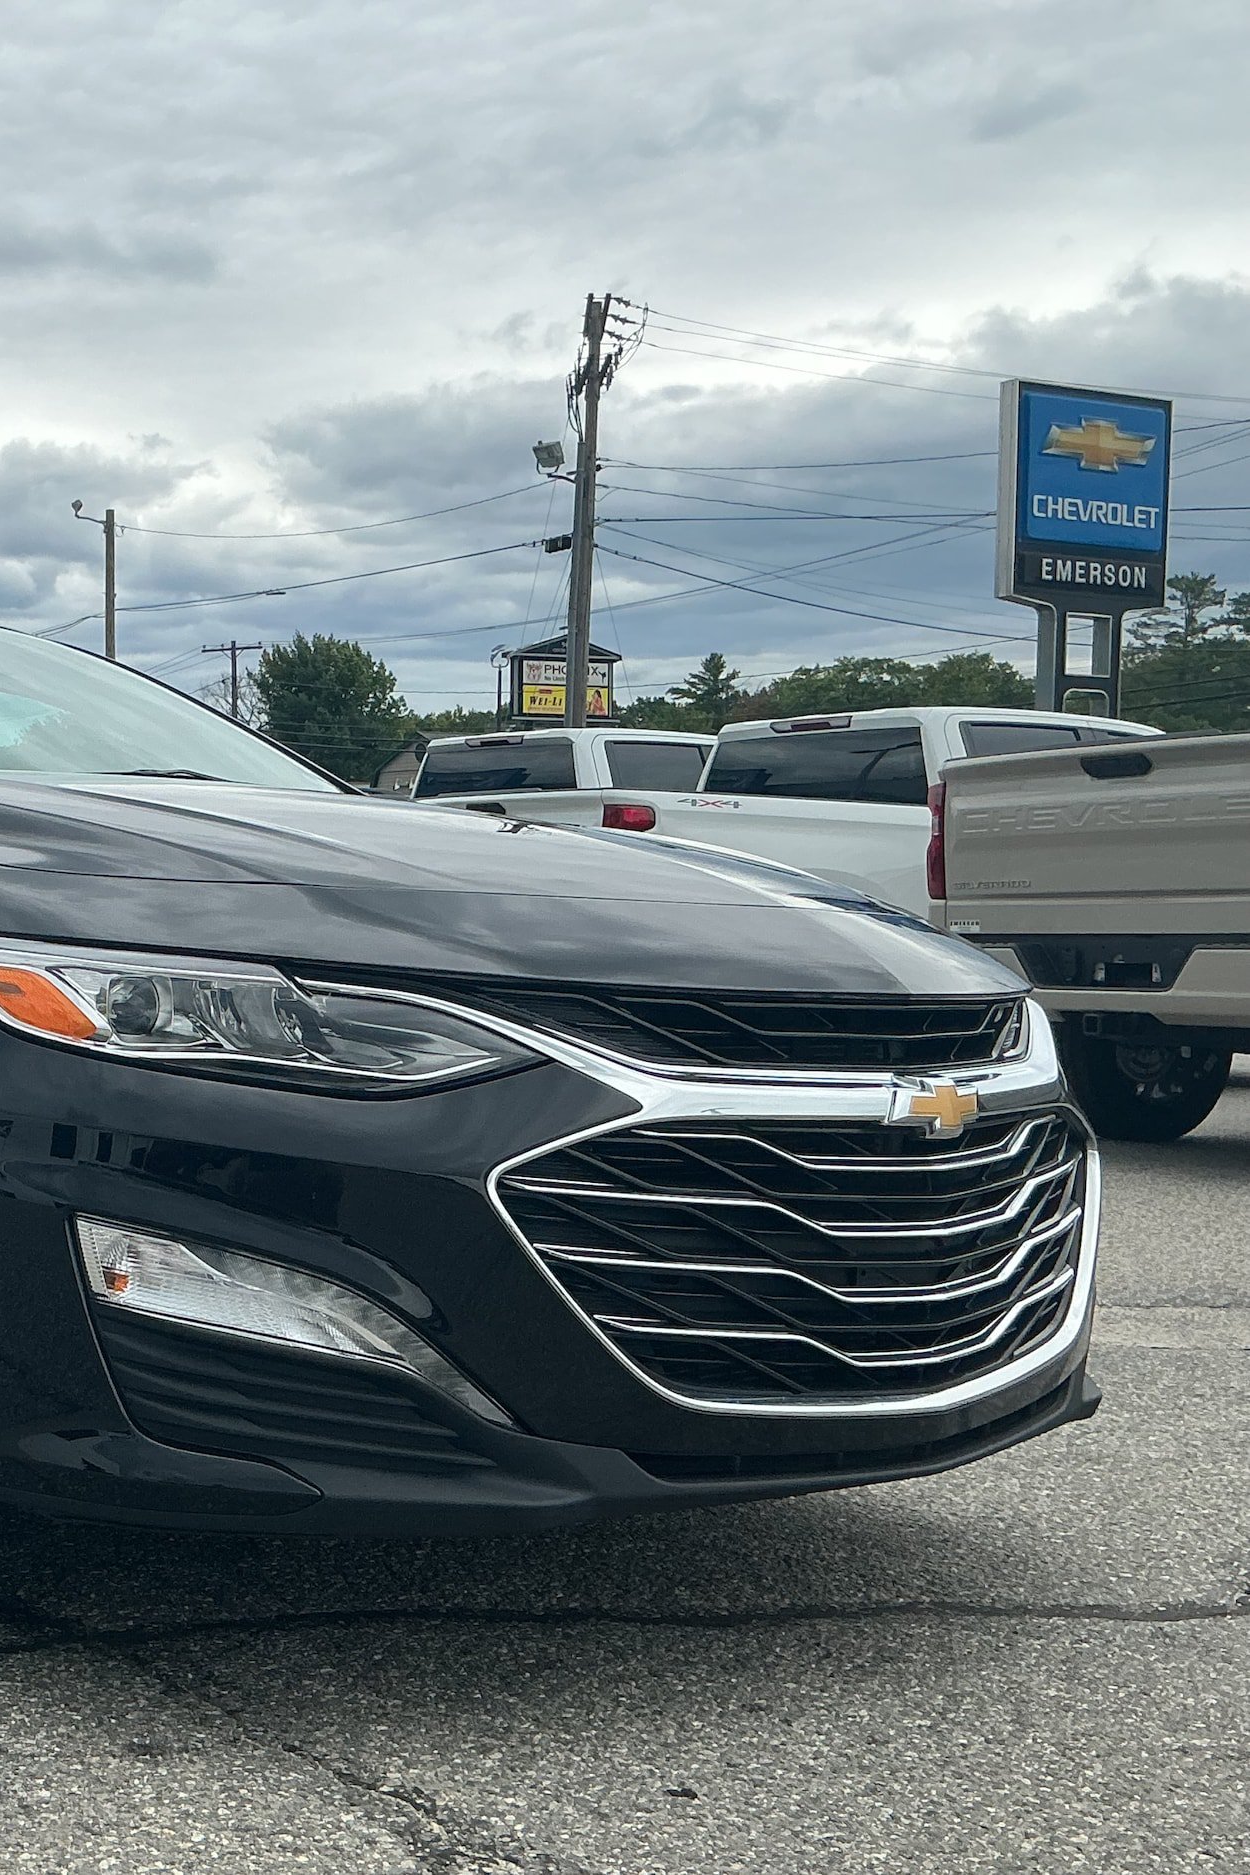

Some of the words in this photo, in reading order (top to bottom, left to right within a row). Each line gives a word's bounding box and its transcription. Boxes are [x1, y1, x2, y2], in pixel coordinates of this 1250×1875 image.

[1032, 494, 1160, 529] CHEVROLET
[1041, 557, 1146, 589] EMERSON
[544, 664, 599, 676] PHOIX
[529, 695, 563, 706] WEI-LI
